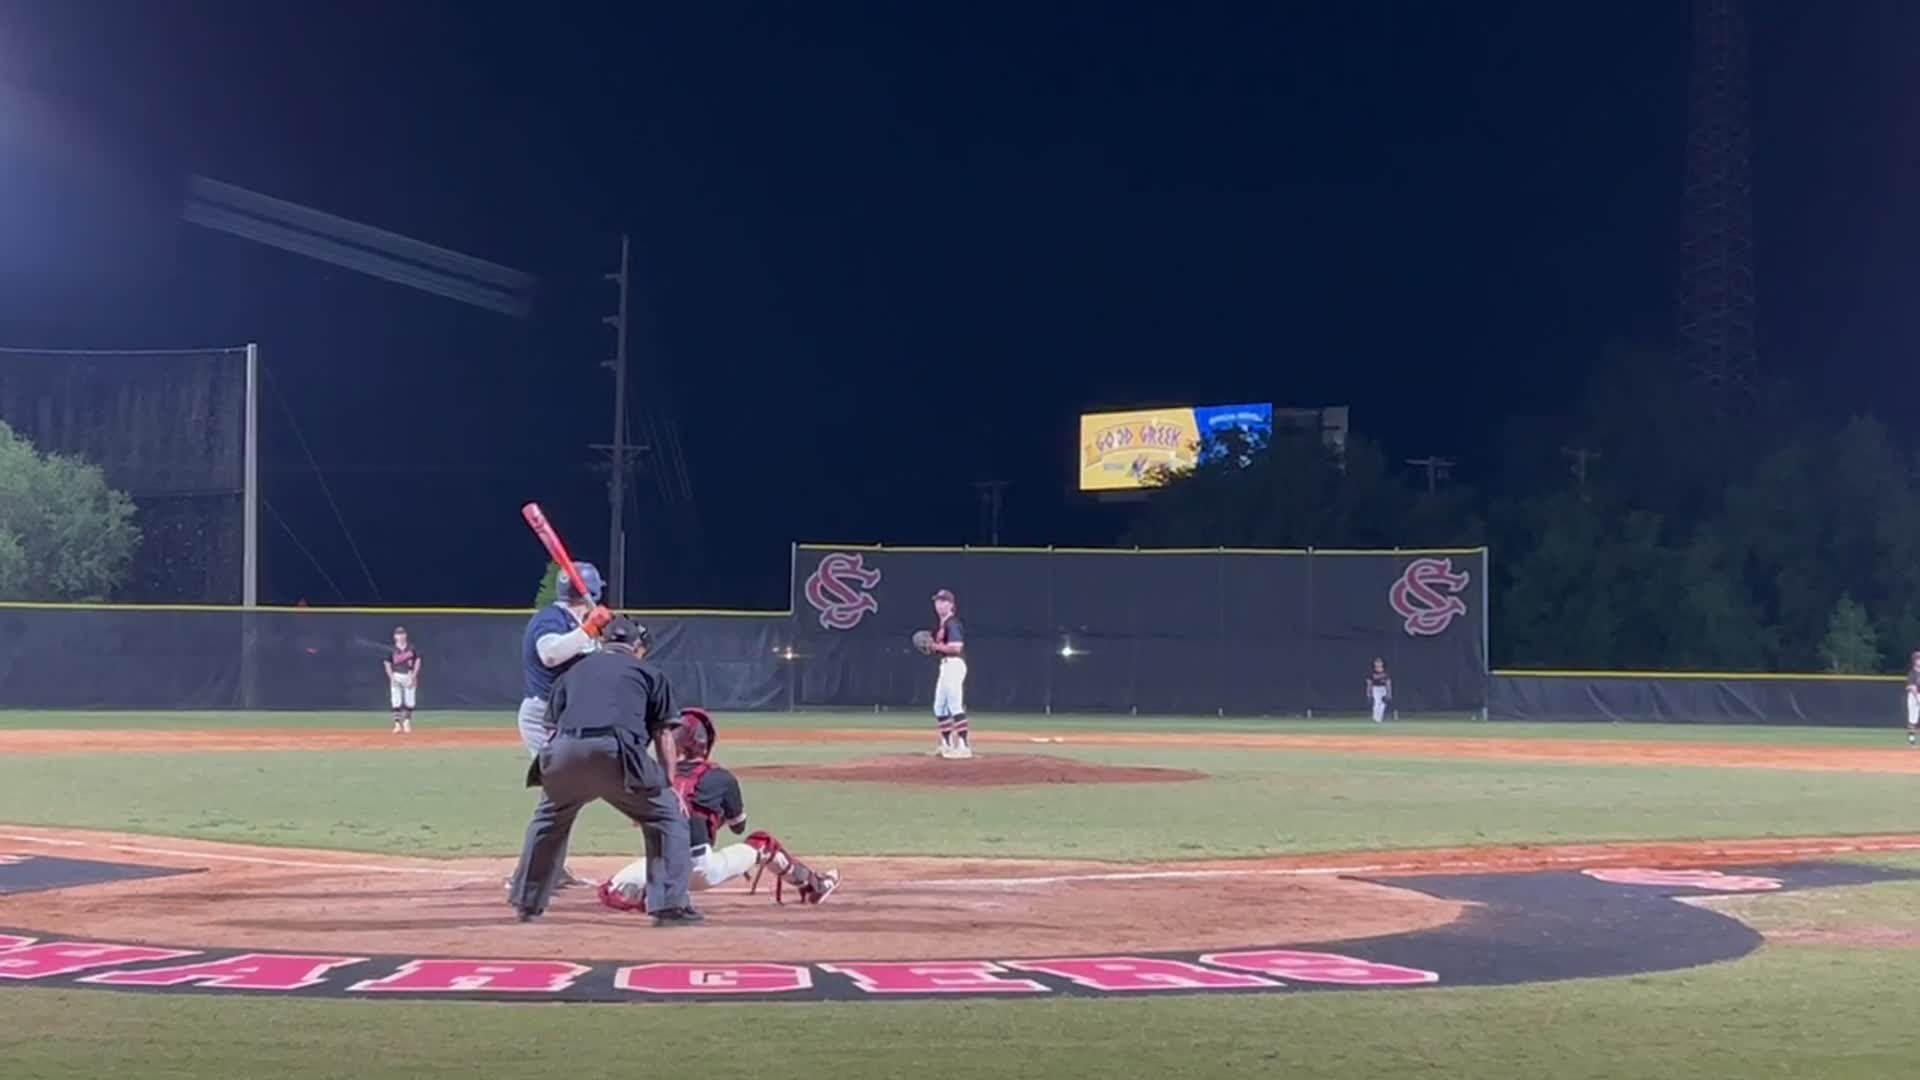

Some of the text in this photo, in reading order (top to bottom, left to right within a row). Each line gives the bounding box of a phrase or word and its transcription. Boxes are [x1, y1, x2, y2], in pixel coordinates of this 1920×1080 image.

[1095, 423, 1183, 453] GOOD GREEK
[0, 934, 1439, 994] HARGERS
